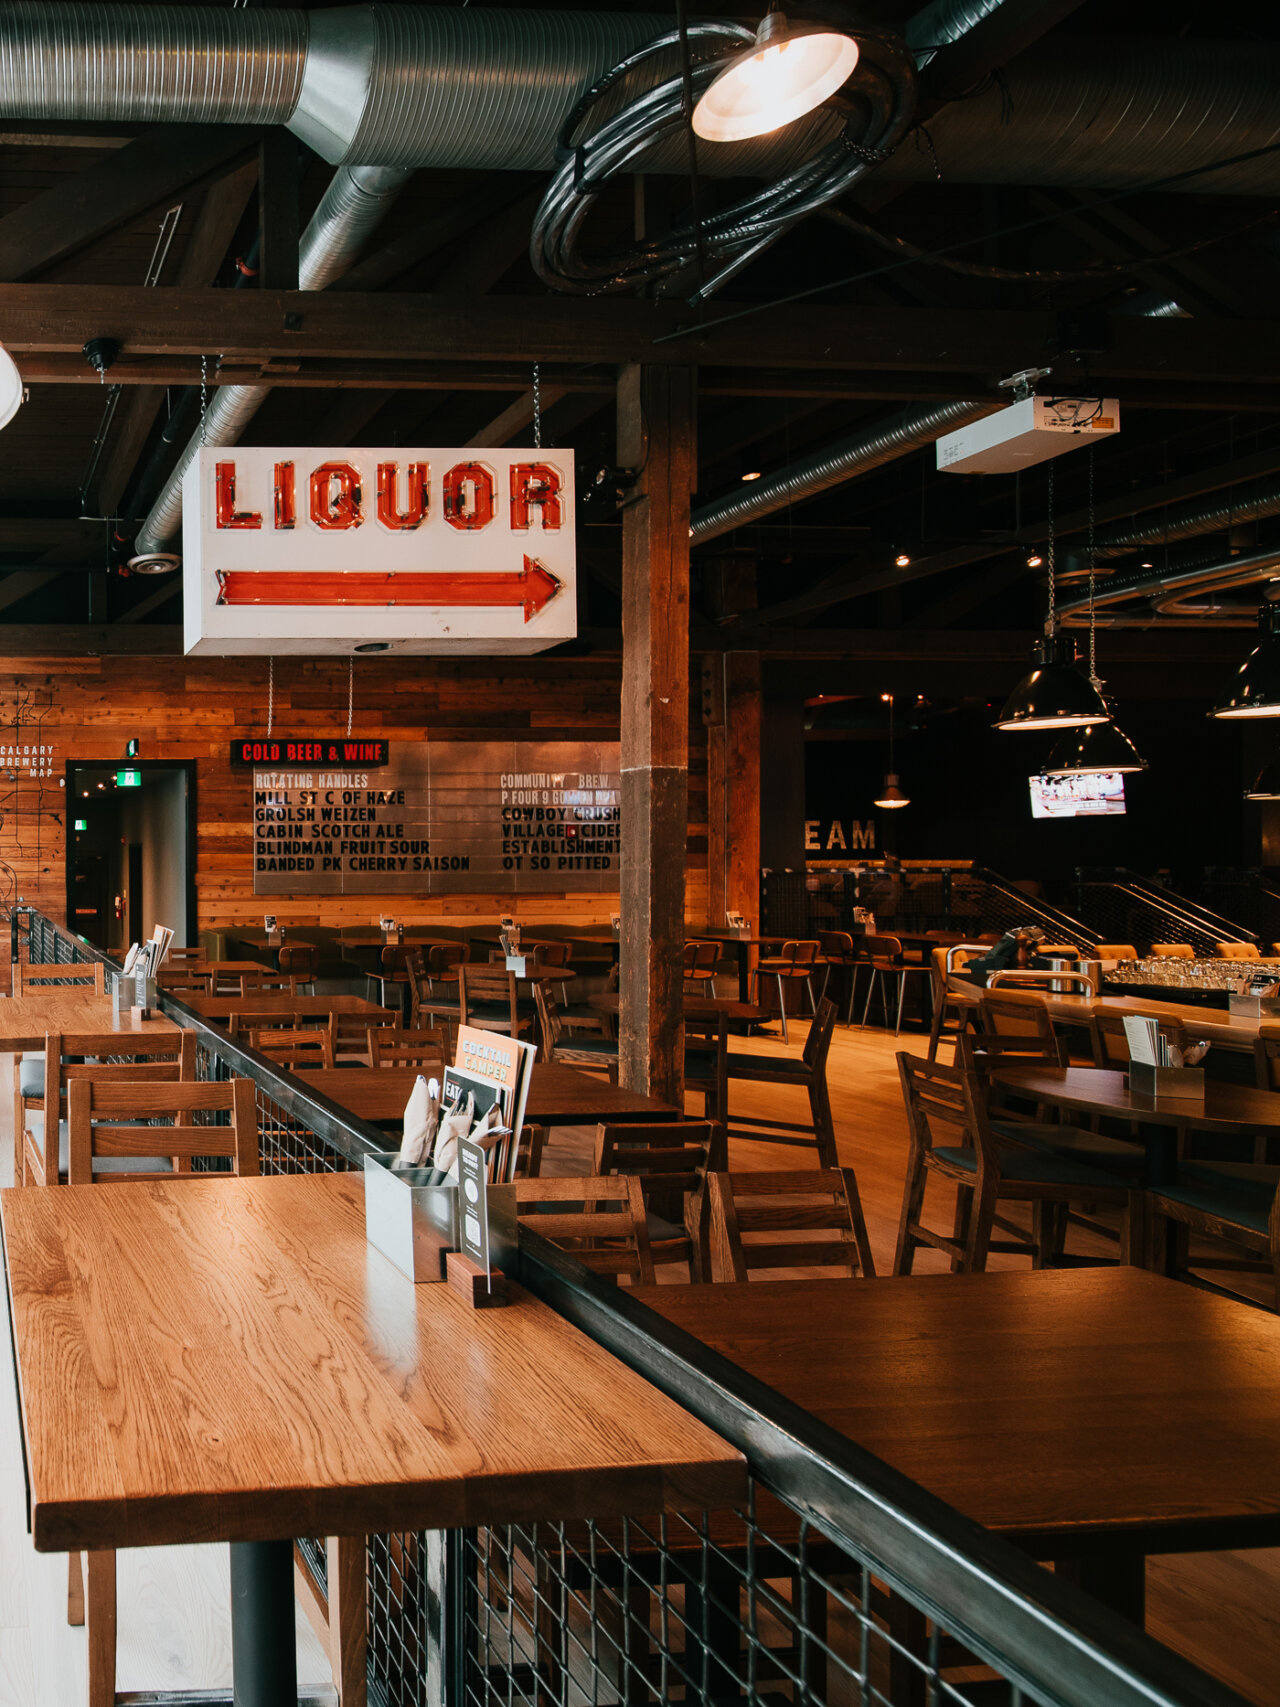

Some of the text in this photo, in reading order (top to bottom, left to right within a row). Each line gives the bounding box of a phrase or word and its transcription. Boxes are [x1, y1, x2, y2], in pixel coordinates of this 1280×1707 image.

[216, 459, 567, 531] LIQUOR
[0, 745, 53, 755] CALGARY
[242, 743, 382, 761] COLD BEER & WINE
[0, 757, 53, 767] BREWERY
[29, 768, 53, 777] MAP
[255, 773, 368, 788] ROTATING HANDLES
[578, 774, 609, 789] BREW
[255, 791, 292, 805] MILL
[299, 791, 318, 805] ST
[342, 791, 361, 805] OF
[367, 791, 405, 805] HAZE
[511, 790, 539, 805] FOUR
[255, 807, 376, 821] GROLSH WEIZEN
[501, 807, 567, 821] COWBOY
[256, 824, 404, 838] CABIN SCOTCH ALE
[502, 823, 565, 838] VILLAGE
[804, 820, 875, 850] EAM
[256, 840, 430, 855] BLINDMAN FRUIT SOUR
[502, 840, 620, 854] ESTABLISHMENT
[256, 857, 470, 871] BANDED PK CHERRY SAISON
[531, 856, 550, 870] SO
[558, 856, 611, 870] PITTED
[462, 1039, 512, 1068] COCKTAIL
[464, 1056, 507, 1083] CAMPER
